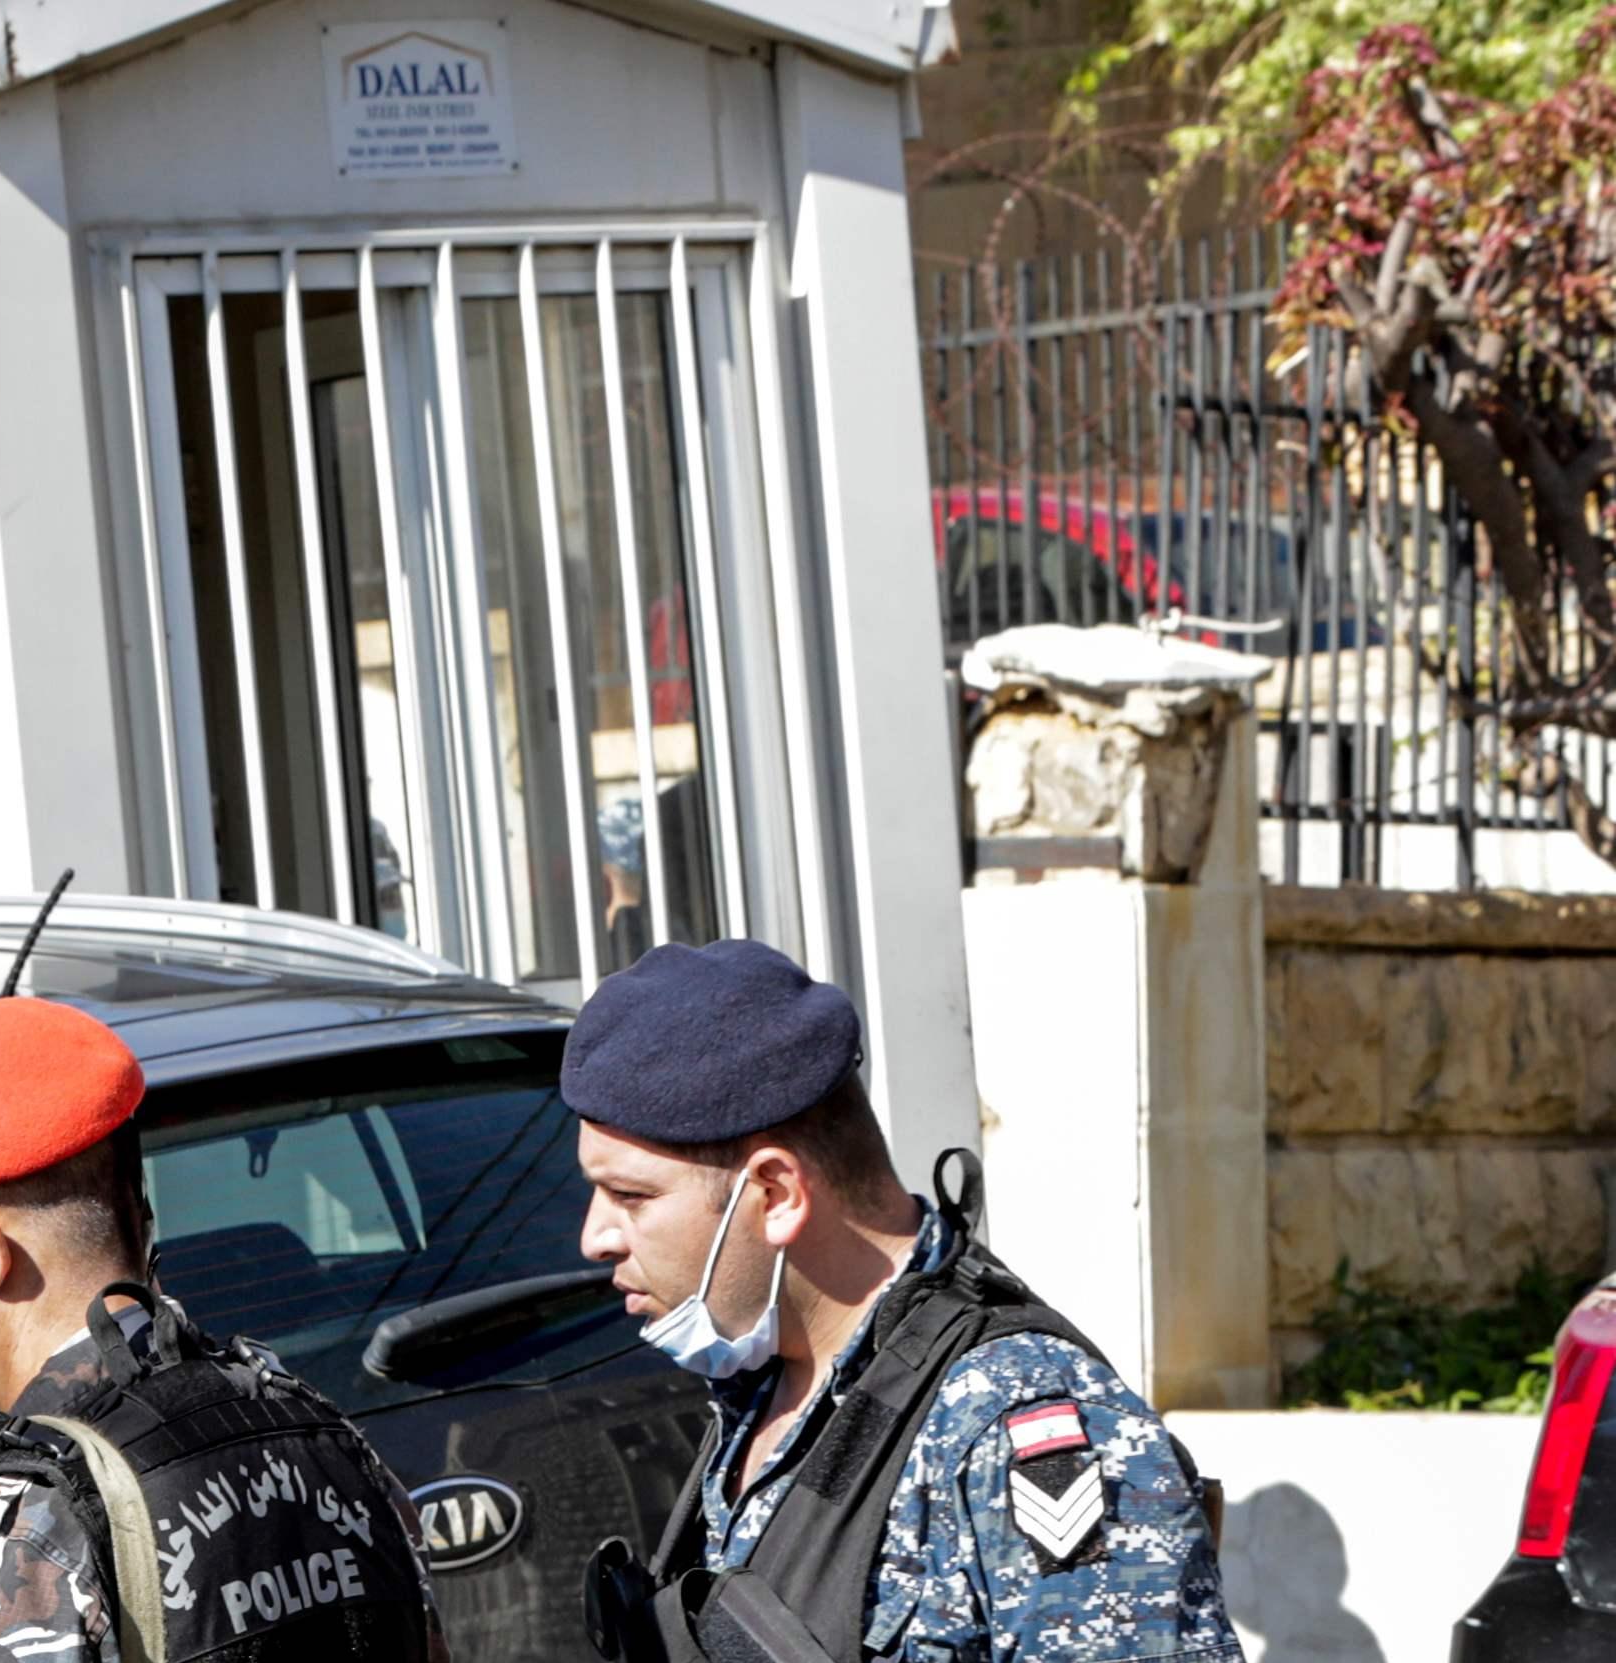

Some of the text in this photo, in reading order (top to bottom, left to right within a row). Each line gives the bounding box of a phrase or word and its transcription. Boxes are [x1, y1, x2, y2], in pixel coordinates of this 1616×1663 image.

[357, 63, 480, 97] DALAL
[419, 1490, 507, 1552] KIA
[220, 1547, 365, 1635] POLICE
